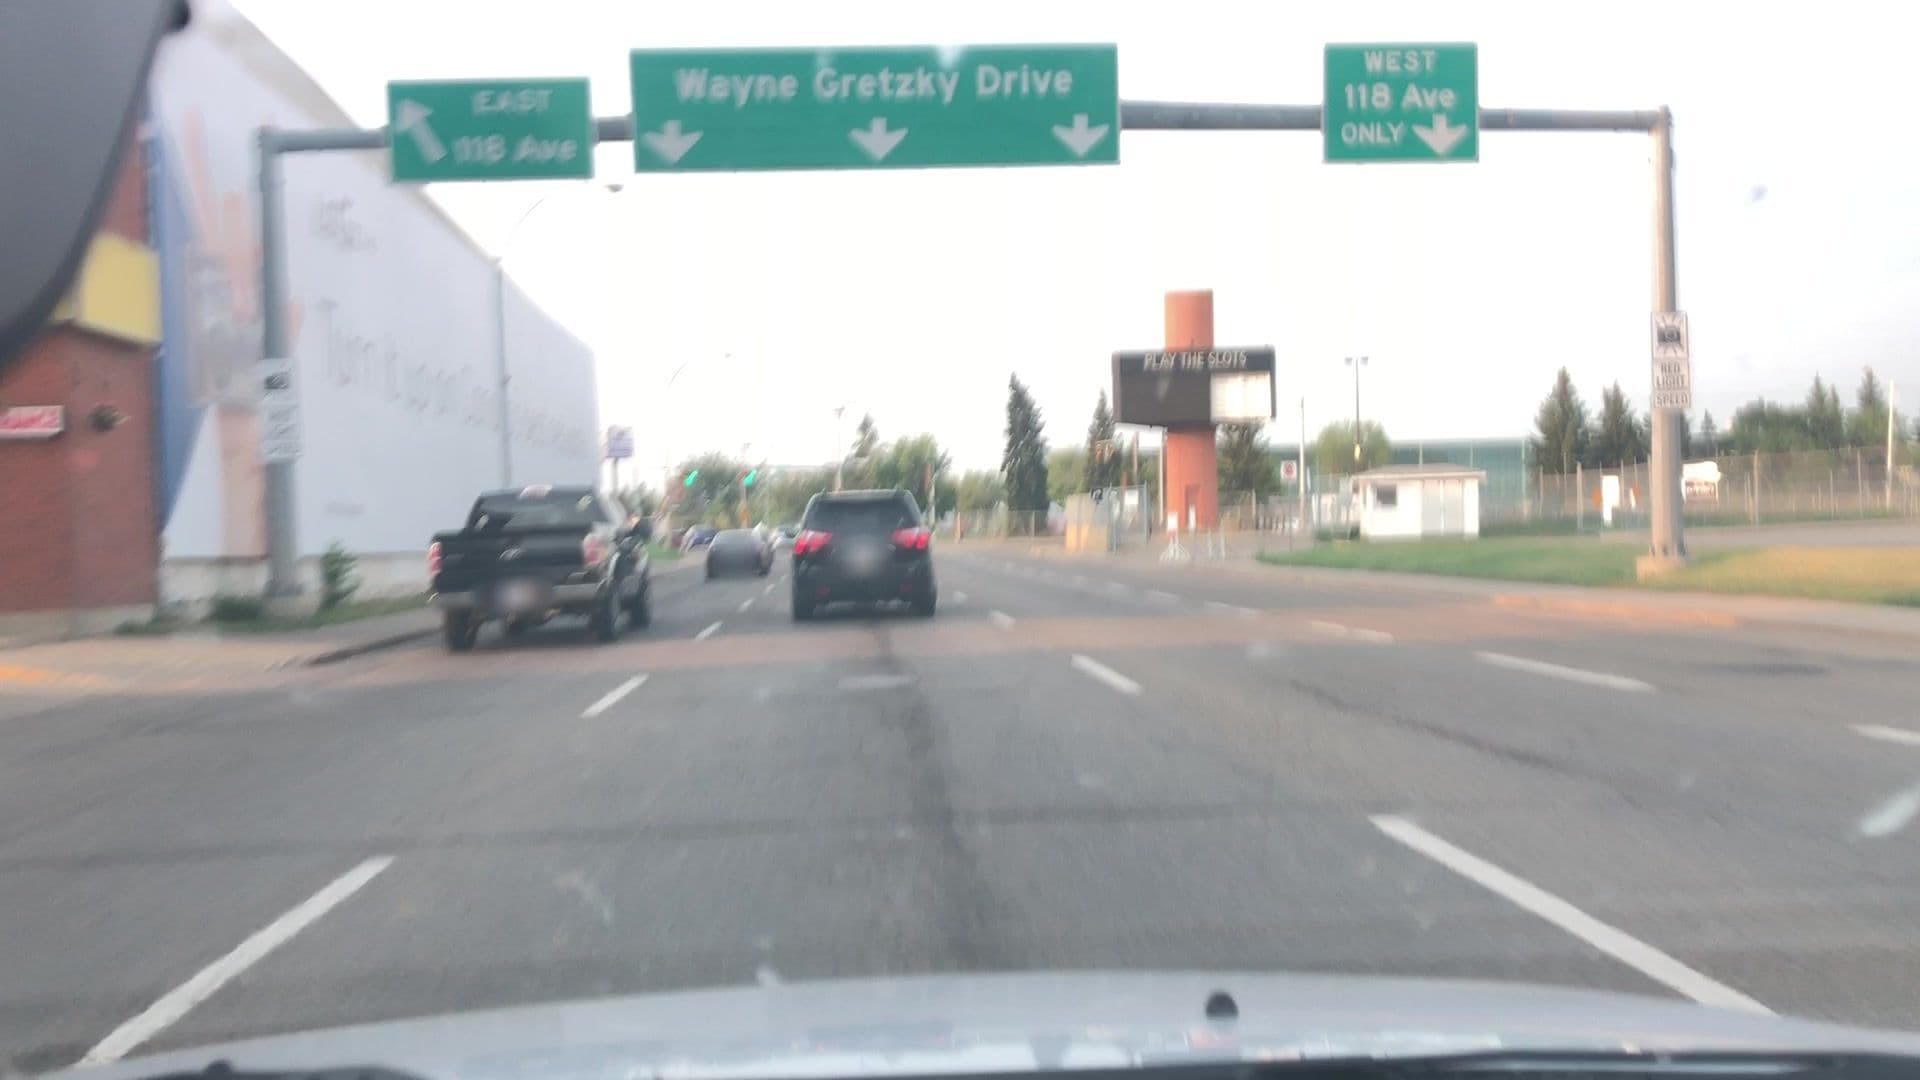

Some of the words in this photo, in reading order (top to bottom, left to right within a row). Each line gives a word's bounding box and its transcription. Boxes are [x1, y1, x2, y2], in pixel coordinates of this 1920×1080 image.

[1364, 50, 1437, 73] WEST
[676, 67, 799, 109] Wayne
[814, 66, 959, 106] Gretzky
[976, 64, 1073, 97] Drive
[1344, 82, 1392, 109] 118
[1402, 82, 1457, 109] Ave
[472, 89, 553, 115] EAST
[1341, 121, 1404, 146] ONLY
[453, 134, 506, 164] 118
[512, 134, 578, 162] Ave
[1144, 350, 1177, 371] PLAY
[1181, 350, 1204, 369] THE
[1207, 350, 1248, 368] SLOTS
[1660, 361, 1681, 374] RED
[1656, 375, 1685, 388] LIGHT
[1656, 393, 1688, 405] SPEED
